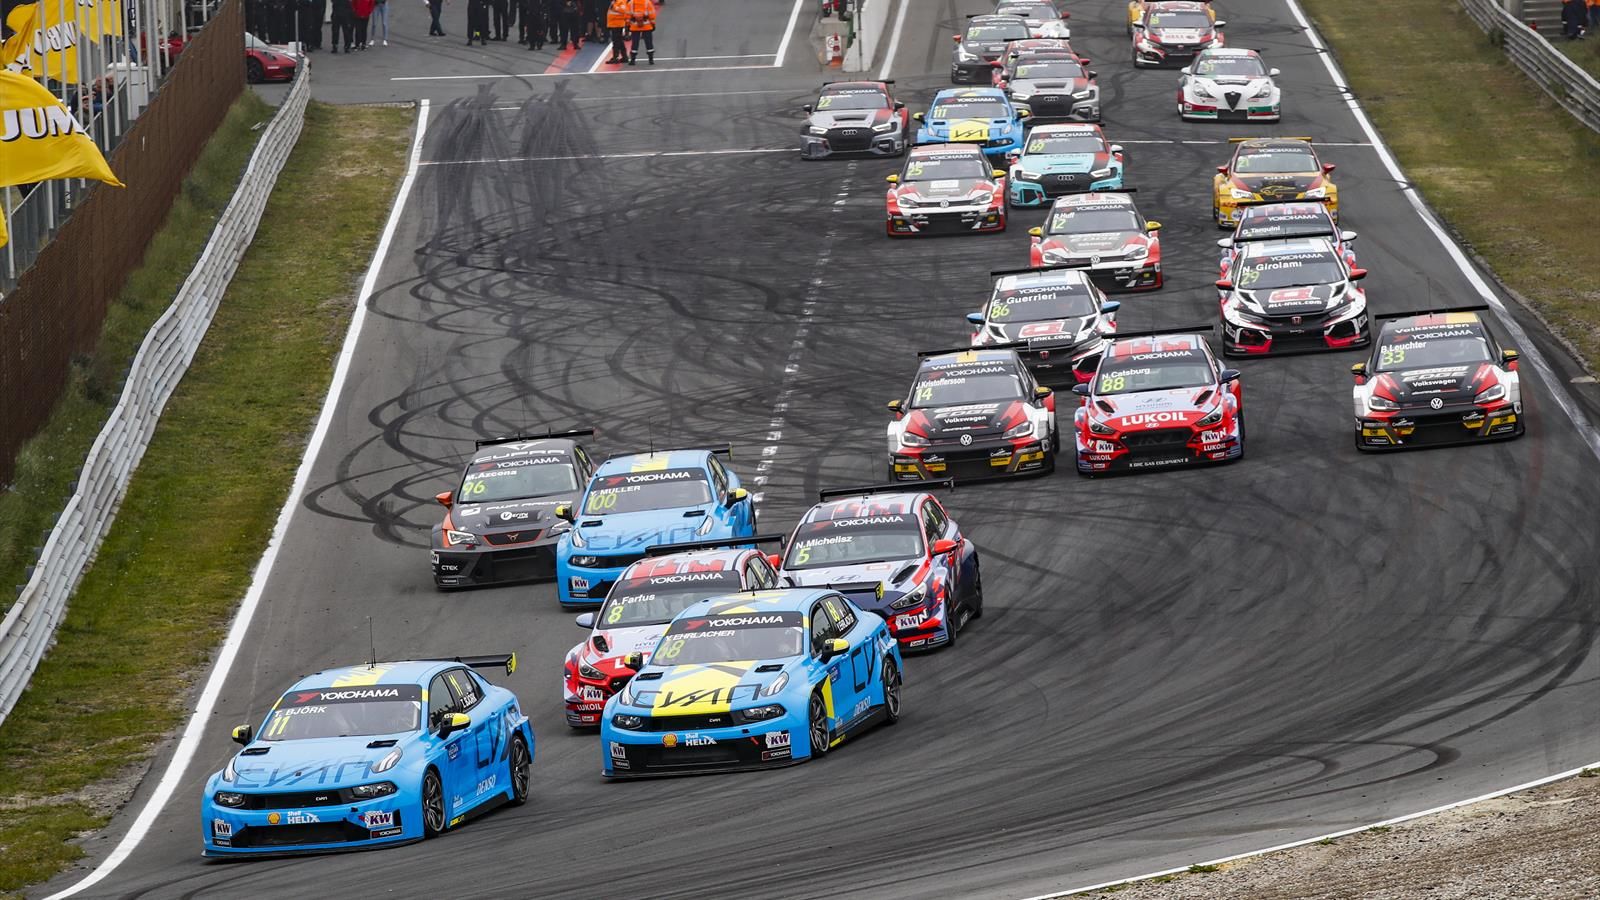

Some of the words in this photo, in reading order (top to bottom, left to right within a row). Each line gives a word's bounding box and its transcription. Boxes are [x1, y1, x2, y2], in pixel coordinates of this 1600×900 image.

[1268, 214, 1319, 222] YOKOHAMA
[1270, 253, 1324, 261] YOKOHAMA
[1256, 261, 1302, 271] Girolami
[1240, 271, 1260, 286] 29
[1018, 285, 1073, 295] YOKOHAMA
[1006, 292, 1057, 304] Guerrieri
[991, 304, 1010, 319] 86
[1395, 323, 1470, 333] Volkswagen
[1411, 329, 1474, 340] YOKOHAMA
[1131, 350, 1192, 361] YOKOHAMA
[1381, 350, 1405, 365] 33
[930, 360, 1004, 370] Volkswagen
[945, 366, 1006, 377] YOKOHAMA
[1101, 376, 1125, 393] 88
[1412, 379, 1457, 387] Volkswagen
[916, 387, 933, 401] 14
[1121, 411, 1188, 427] LUKOIL
[1203, 443, 1226, 451] LUKOIL
[475, 450, 565, 463] CUPRA
[496, 456, 560, 468] YOKOHAMA
[626, 471, 691, 484] YOKOHAMA
[462, 480, 486, 496] 96
[599, 485, 641, 495] MULLER
[588, 493, 617, 512] 100
[833, 515, 904, 528] YOKOHAMA
[794, 547, 811, 566] 5
[650, 572, 724, 585] YOKOHAMA
[607, 605, 624, 625] 8
[708, 615, 784, 628] YOKOHAMA
[900, 617, 917, 627] KW
[655, 639, 685, 660] 68
[320, 689, 399, 701] YOKOHAMA
[586, 690, 602, 698] KW
[285, 706, 328, 716] BJÖRK
[577, 703, 603, 711] LUKOIL
[268, 715, 291, 737] 11
[685, 735, 718, 747] HELIX
[771, 735, 789, 745] KW
[288, 812, 320, 824] HELIX
[370, 813, 391, 825] KW
